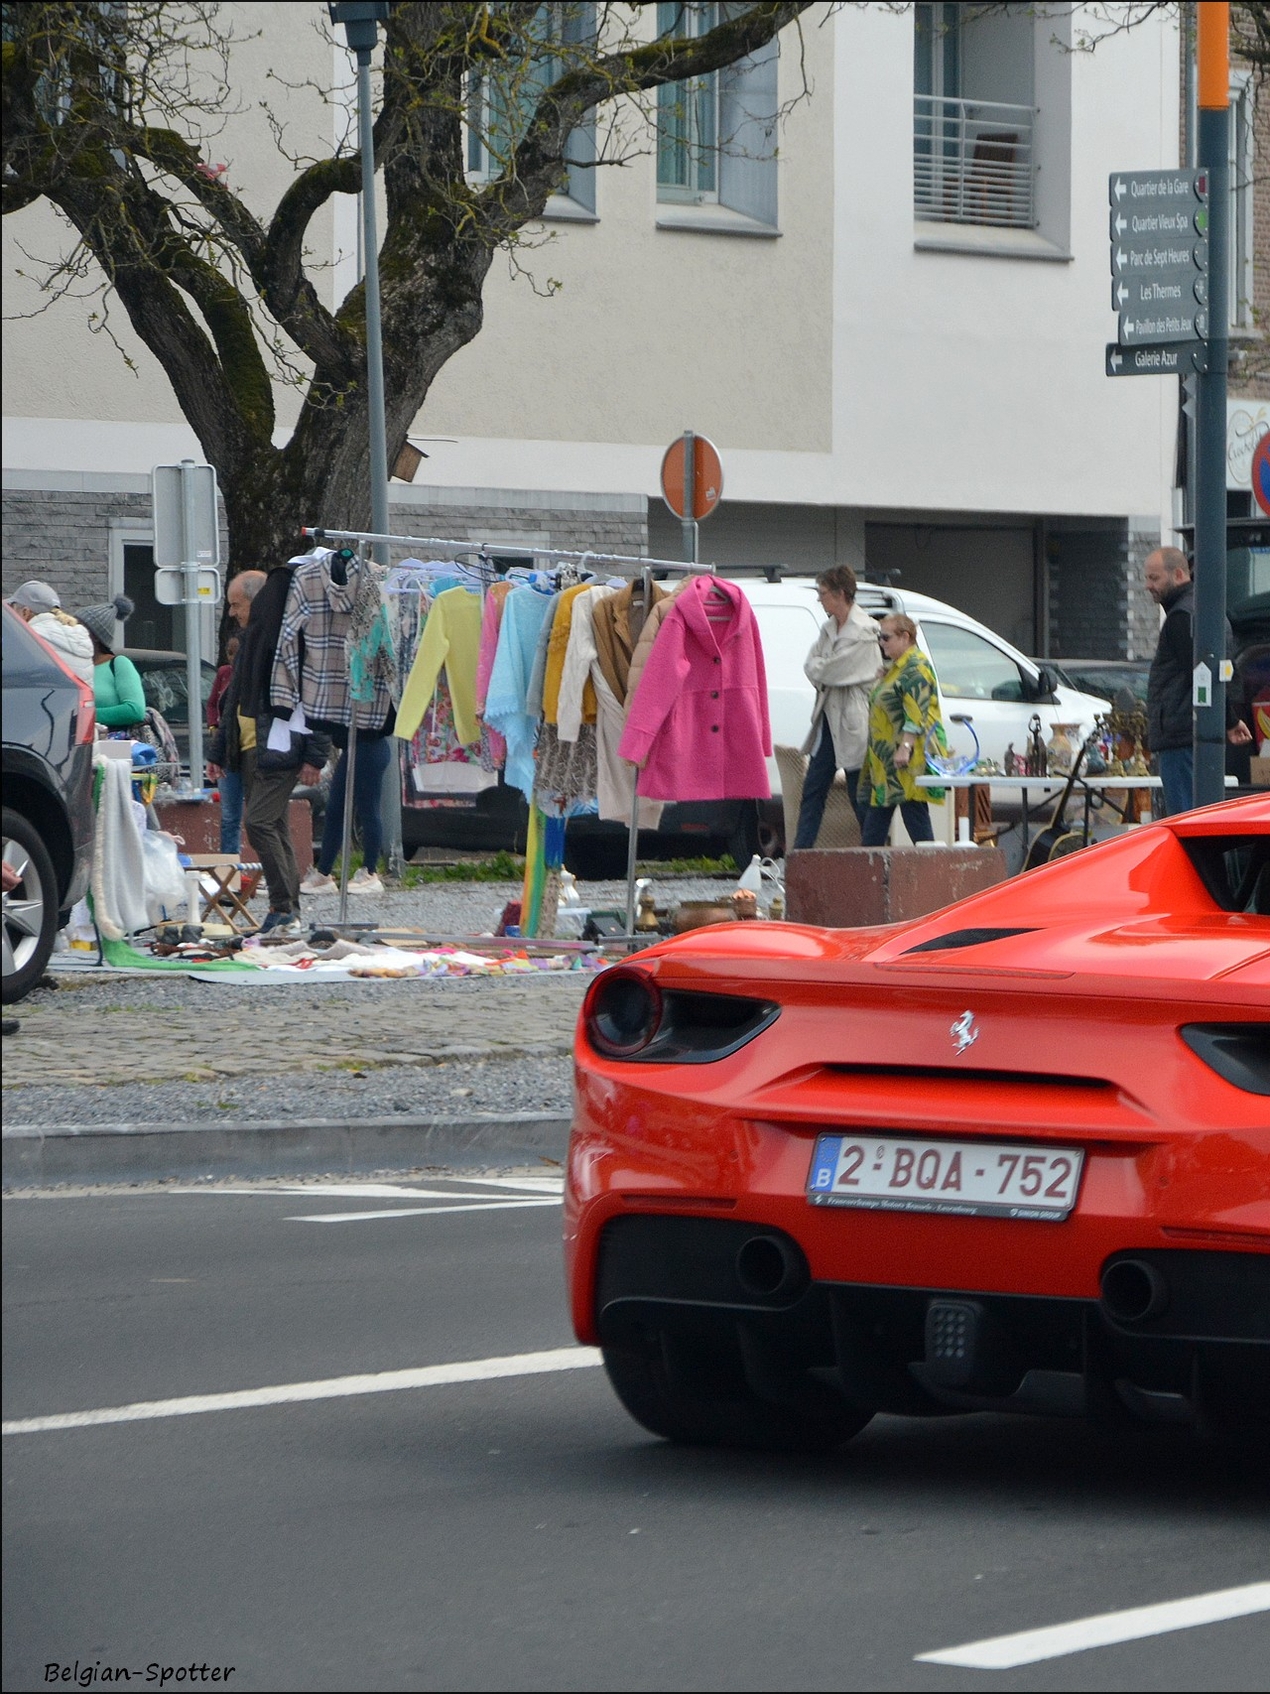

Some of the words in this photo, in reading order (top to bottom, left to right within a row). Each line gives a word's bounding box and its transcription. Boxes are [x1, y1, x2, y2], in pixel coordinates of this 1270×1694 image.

[1131, 182, 1157, 197] Quartier
[1158, 182, 1166, 194] de
[1167, 181, 1173, 193] la
[1174, 180, 1189, 194] Gare
[1132, 216, 1158, 232] Quartier
[1158, 216, 1175, 230] Vieux
[1176, 213, 1189, 231] Spa
[1130, 251, 1143, 266] Parc
[1144, 250, 1153, 264] de
[1154, 249, 1168, 267] Sept
[1168, 249, 1190, 263] Heures
[1140, 286, 1152, 300] Les
[1152, 284, 1182, 299] Thermes
[1136, 319, 1155, 334] Pavillon
[1156, 318, 1165, 331] des
[1166, 316, 1179, 331] Petits
[1135, 351, 1160, 366] Galerie
[1160, 350, 1178, 365] Azur
[815, 1168, 832, 1188] B
[838, 1145, 1072, 1199] 2-BQA-752
